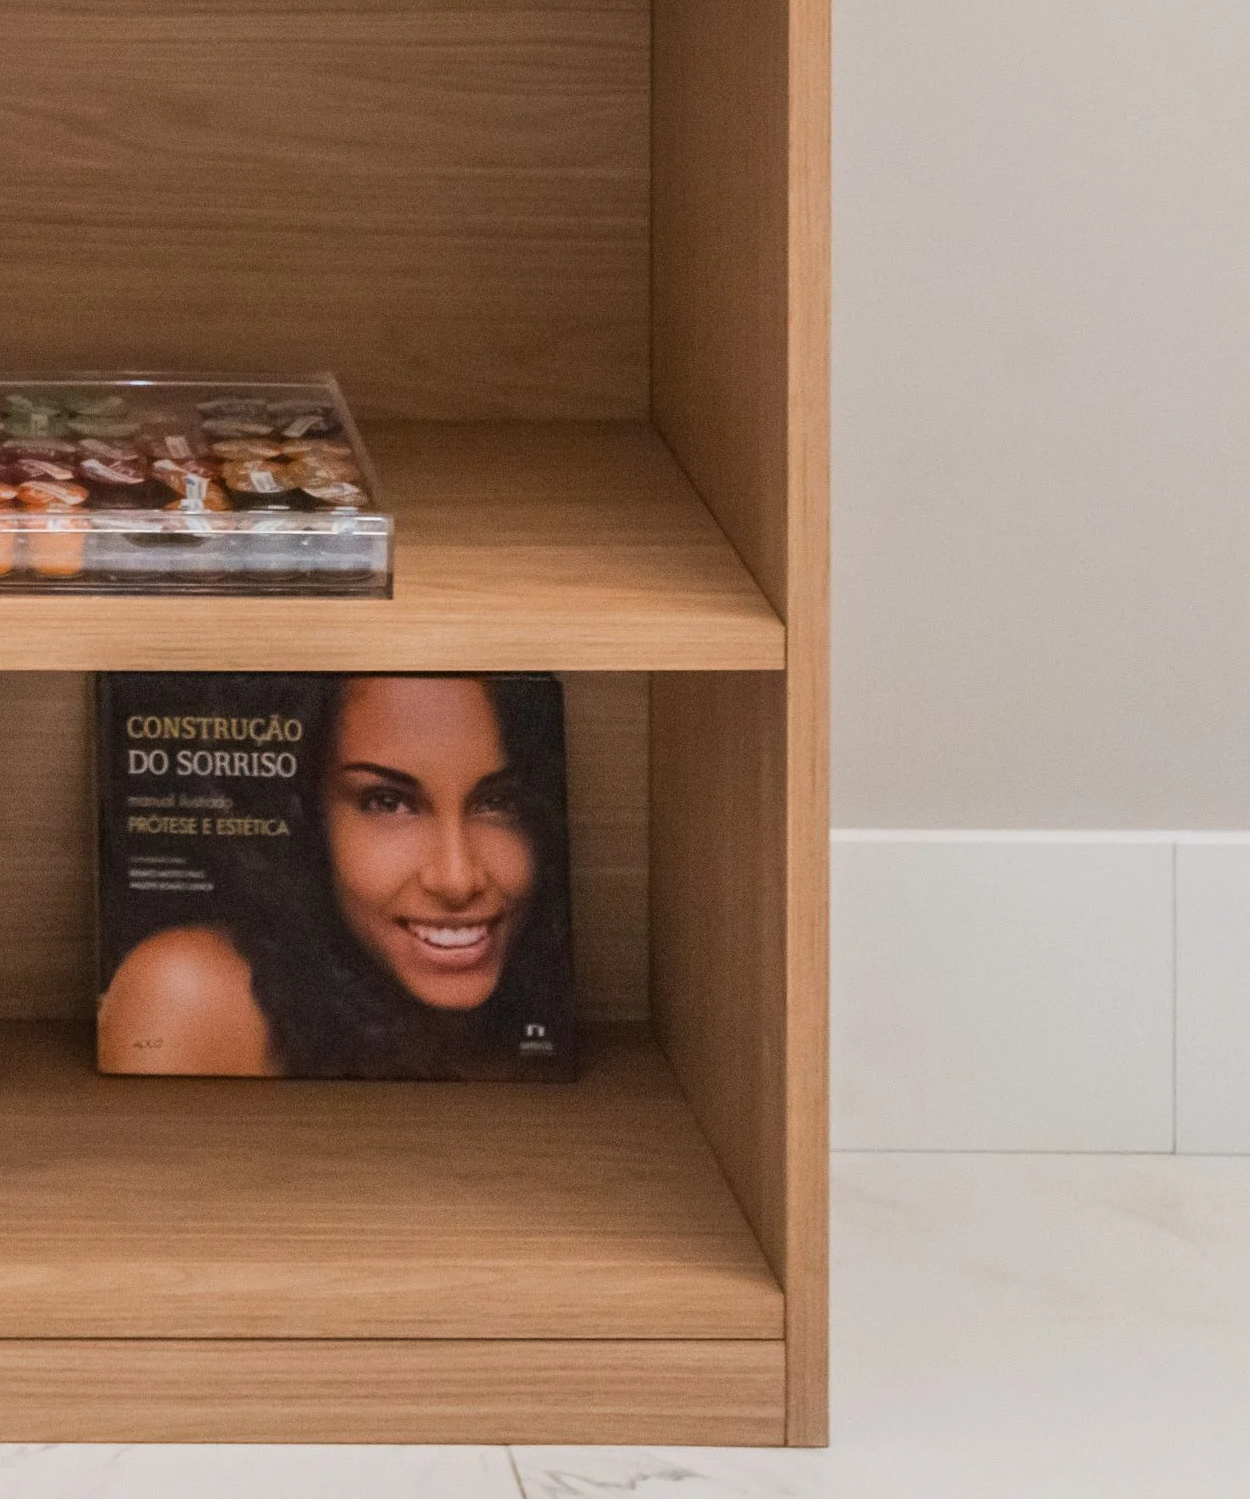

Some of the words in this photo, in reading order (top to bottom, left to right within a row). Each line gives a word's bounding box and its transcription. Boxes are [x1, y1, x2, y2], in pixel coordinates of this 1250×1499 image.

[127, 713, 302, 747] CONSTRUÇÃO
[128, 749, 169, 775] DO
[176, 750, 297, 778] SORRISO
[202, 817, 213, 835] E
